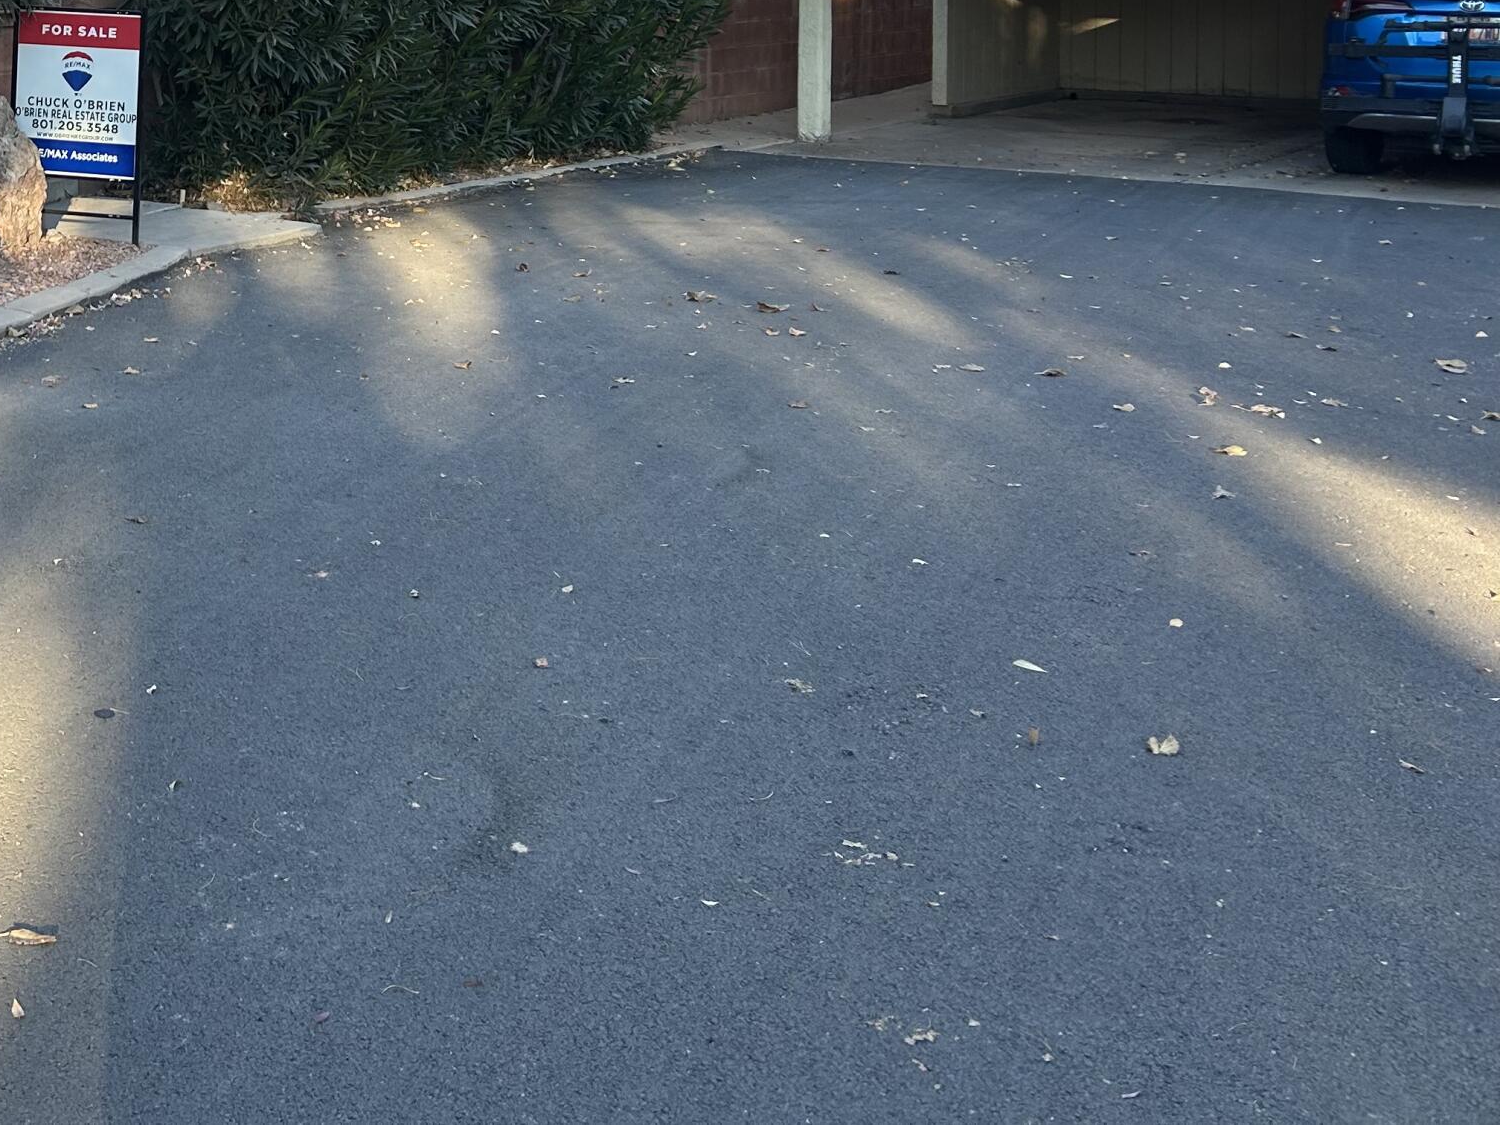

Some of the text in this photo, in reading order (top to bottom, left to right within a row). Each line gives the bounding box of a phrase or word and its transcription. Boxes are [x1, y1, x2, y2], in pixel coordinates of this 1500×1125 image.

[42, 24, 117, 38] FOR SALE
[64, 61, 91, 69] RE/MAX
[1452, 55, 1462, 83] THULE
[28, 96, 125, 112] CHUCK O'BRIEN
[16, 106, 137, 124] O'BRIEN REAL ESTATE GROUP
[32, 119, 118, 134] 801.205.3548
[39, 148, 118, 163] E/MAX Associates
